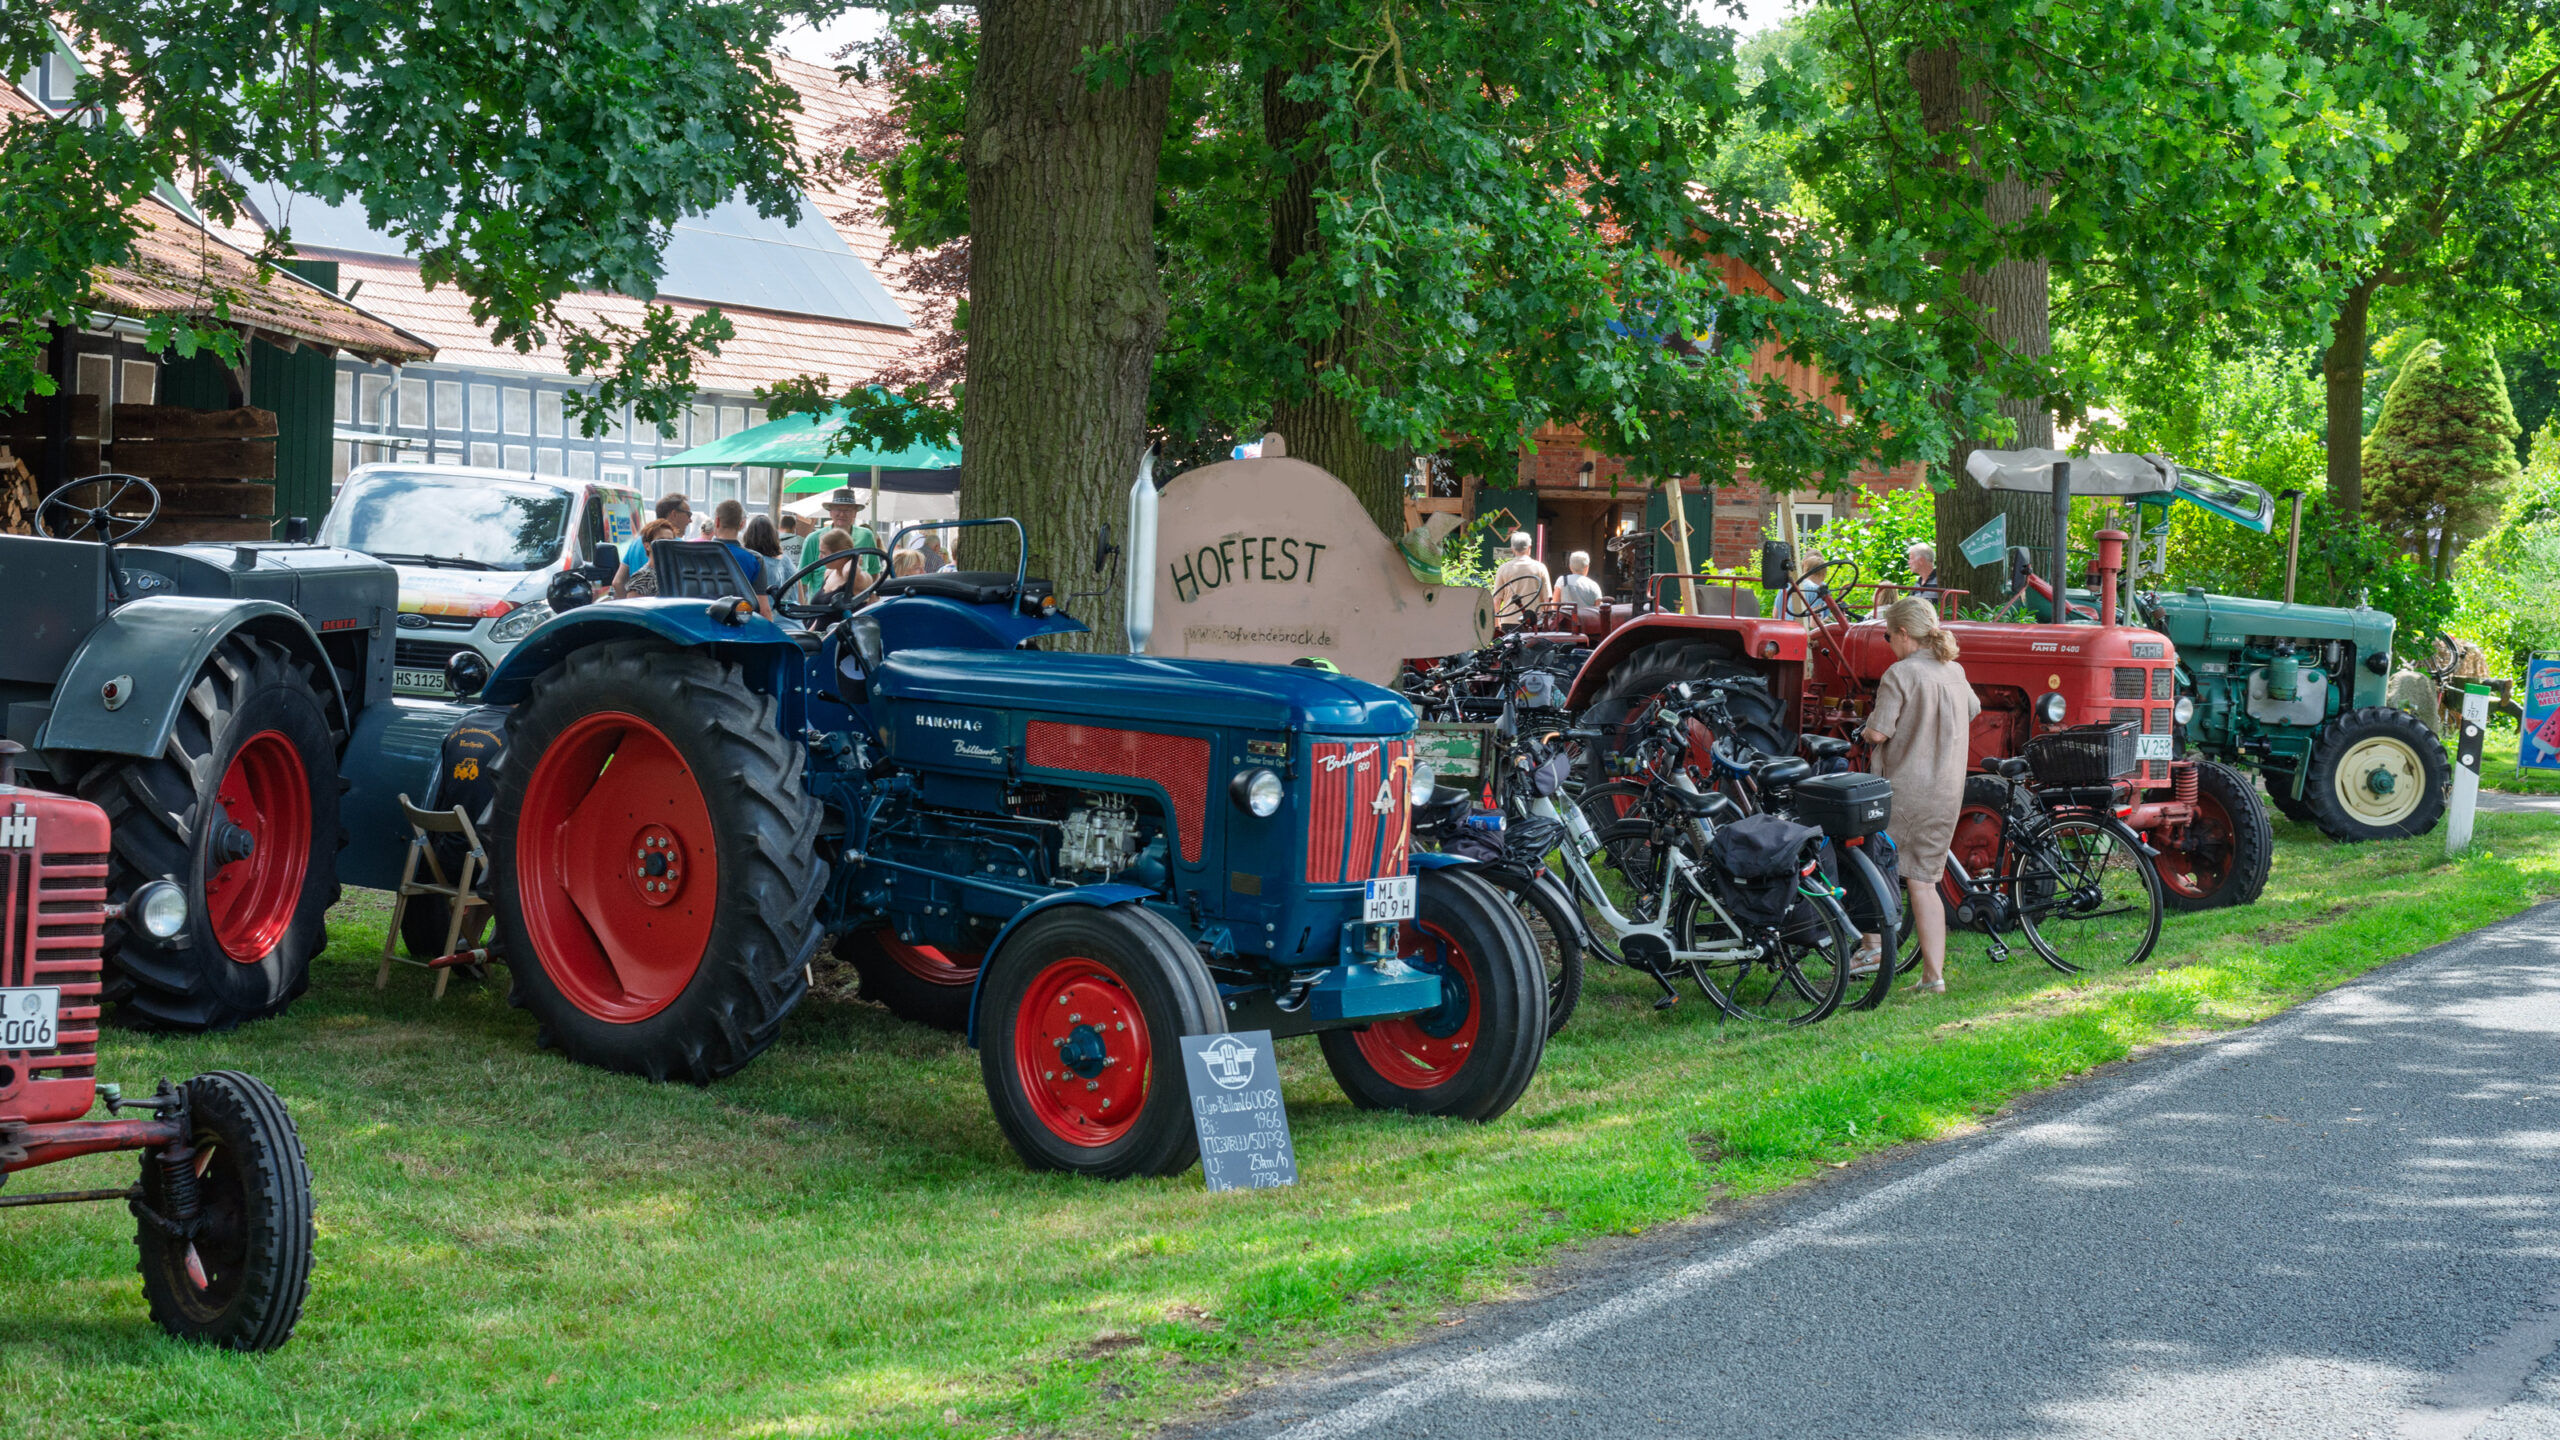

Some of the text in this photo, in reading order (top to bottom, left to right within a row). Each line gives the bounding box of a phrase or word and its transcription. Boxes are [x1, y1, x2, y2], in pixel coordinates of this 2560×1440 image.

[1170, 537, 1326, 602] HOFFEST
[322, 618, 357, 631] DEUTZ
[2031, 642, 2058, 652] FAHR
[2132, 644, 2164, 658] FAHR
[396, 672, 444, 688] HS 1125
[915, 714, 983, 732] HANOMAG
[952, 739, 999, 756] Brillant
[2141, 739, 2150, 756] V
[1317, 743, 1379, 772] Brillant
[1357, 761, 1371, 773] 600
[1378, 882, 1393, 900] MI
[1371, 899, 1410, 919] HQ 9 H
[0, 1019, 51, 1044] 006
[1254, 1111, 1282, 1129] 1966
